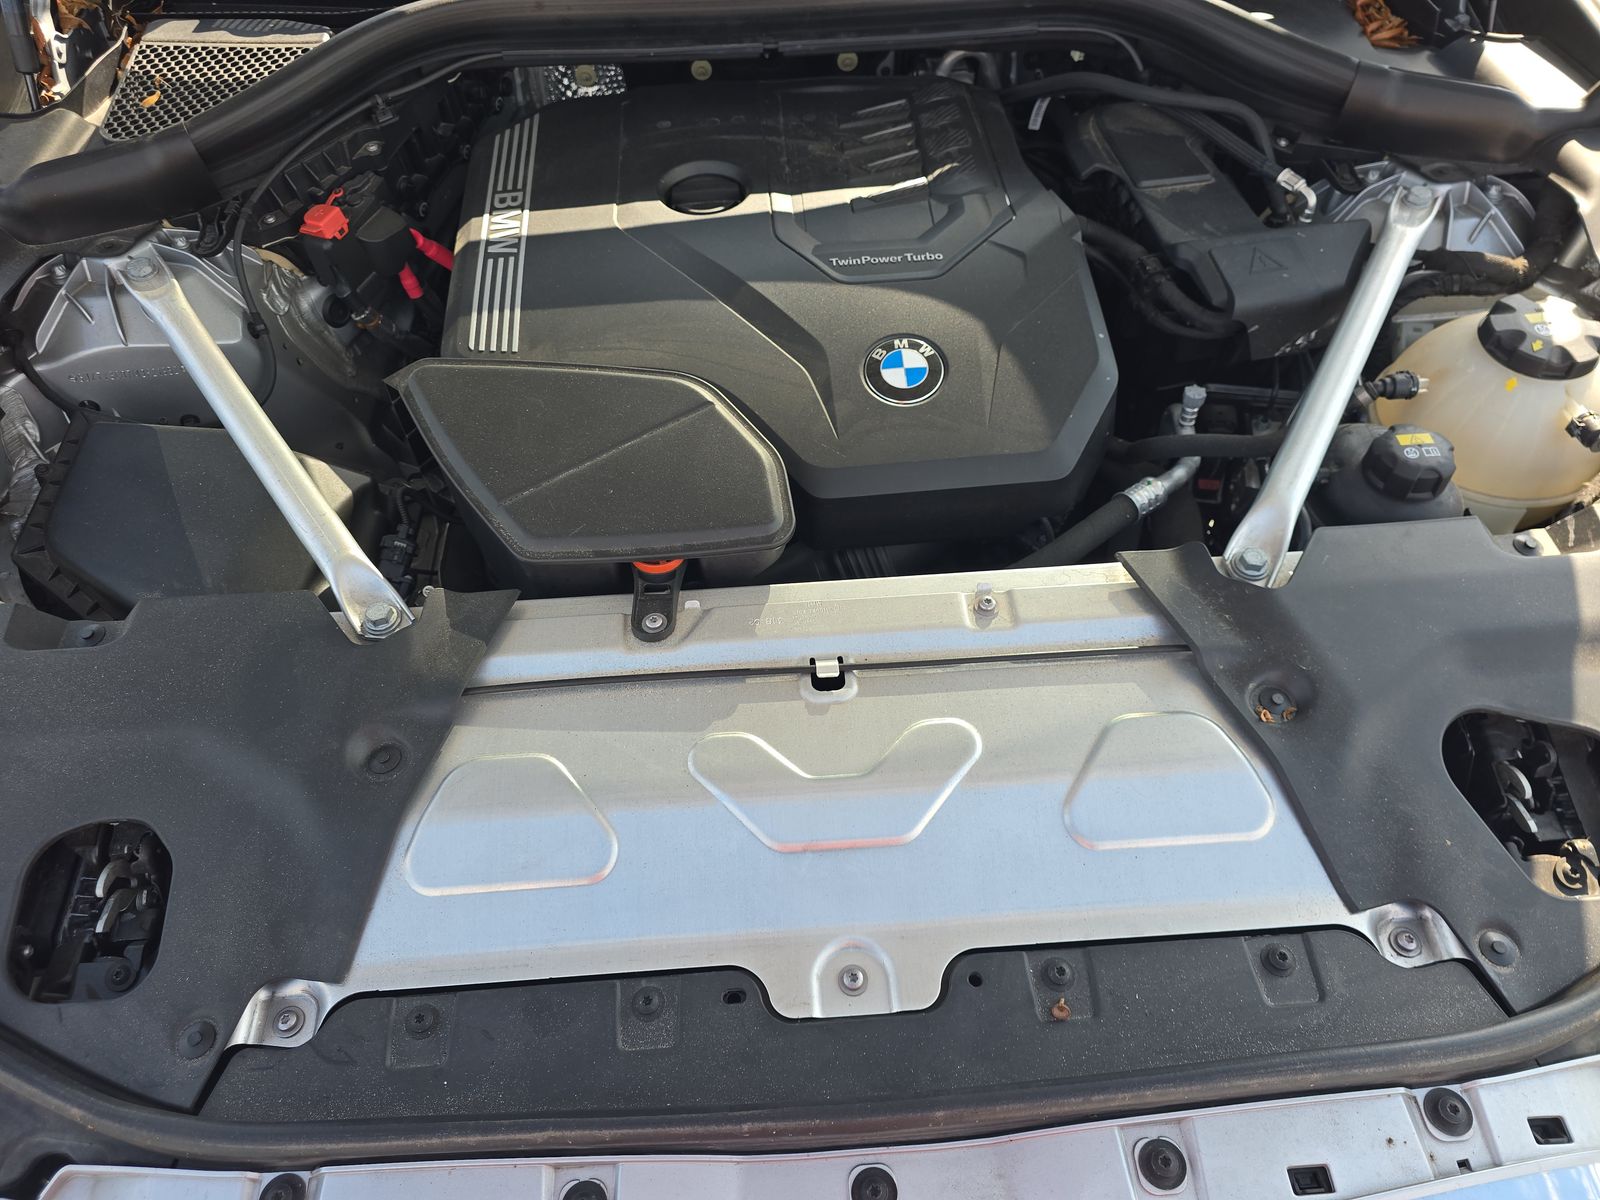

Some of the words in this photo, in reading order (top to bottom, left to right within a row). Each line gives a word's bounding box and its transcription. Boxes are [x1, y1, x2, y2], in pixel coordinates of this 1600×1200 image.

[487, 191, 523, 253] BMW
[904, 252, 944, 262] Turbo
[871, 338, 935, 361] BMW
